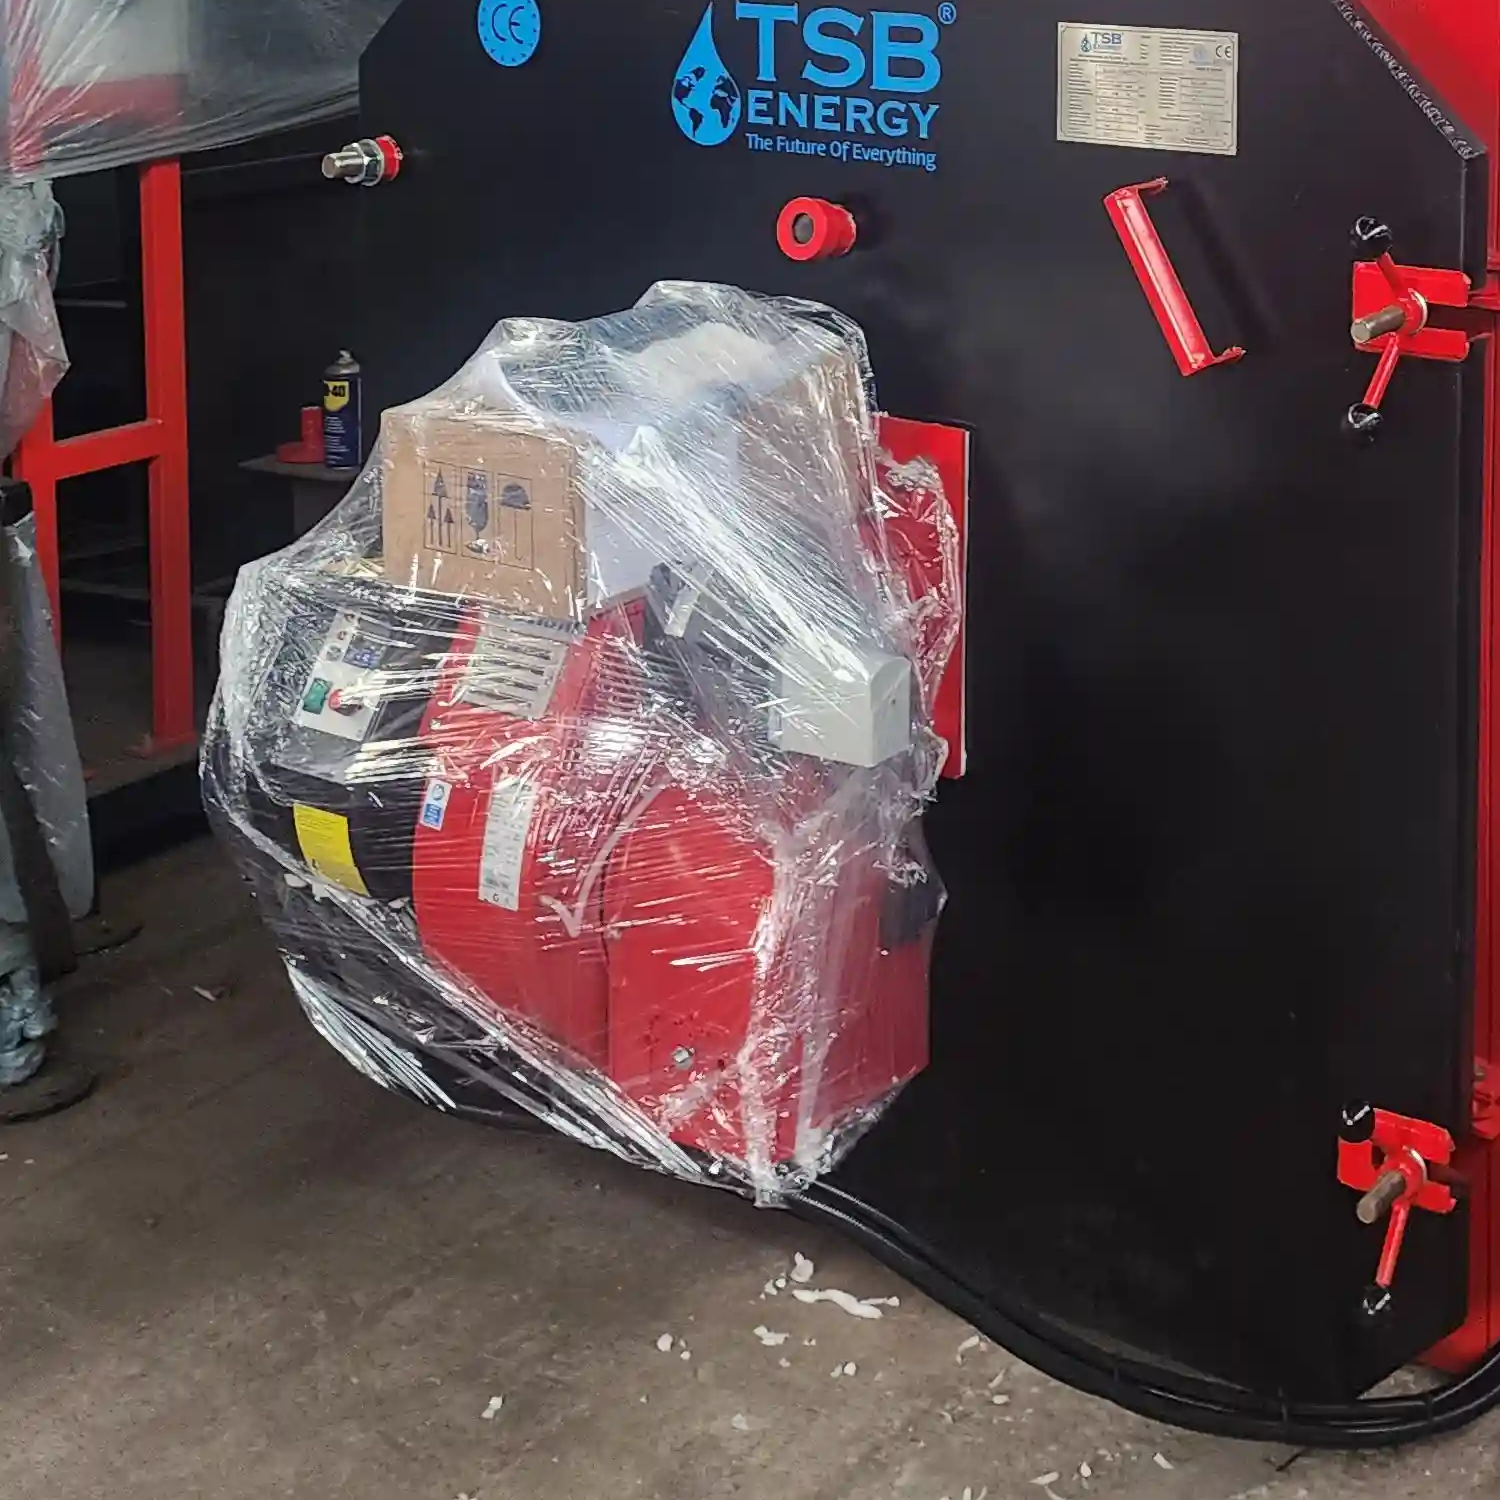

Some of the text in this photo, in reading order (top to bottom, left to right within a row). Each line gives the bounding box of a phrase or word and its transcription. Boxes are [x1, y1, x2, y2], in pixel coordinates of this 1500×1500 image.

[735, 0, 941, 94] TSB
[1089, 31, 1122, 45] TSB
[747, 88, 940, 140] ENERGY
[745, 132, 937, 172] The Future Of Everything
